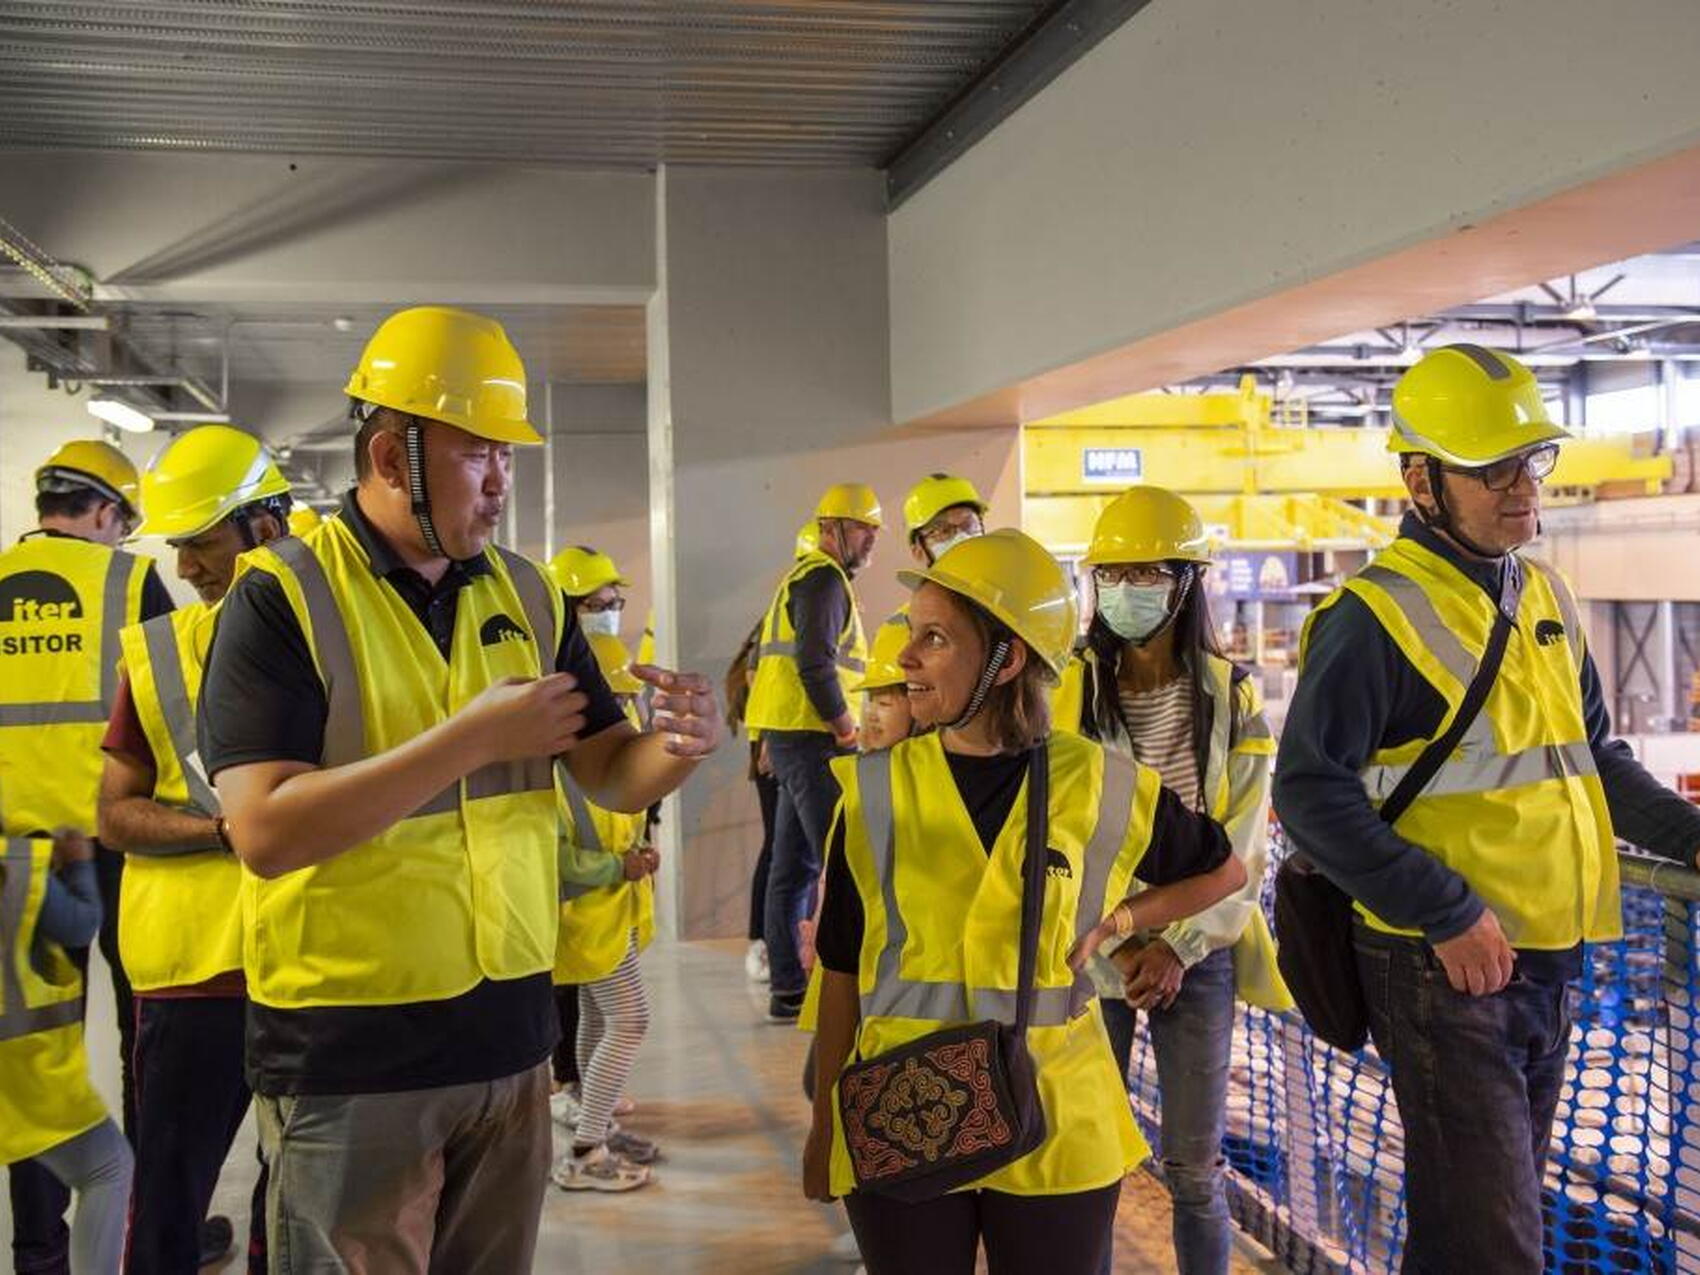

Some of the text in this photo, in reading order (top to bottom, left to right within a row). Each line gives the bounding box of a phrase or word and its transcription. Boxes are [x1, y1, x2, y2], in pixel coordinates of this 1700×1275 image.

[13, 597, 77, 622] iter
[2, 633, 83, 656] SITOR
[1046, 866, 1070, 880] ter
